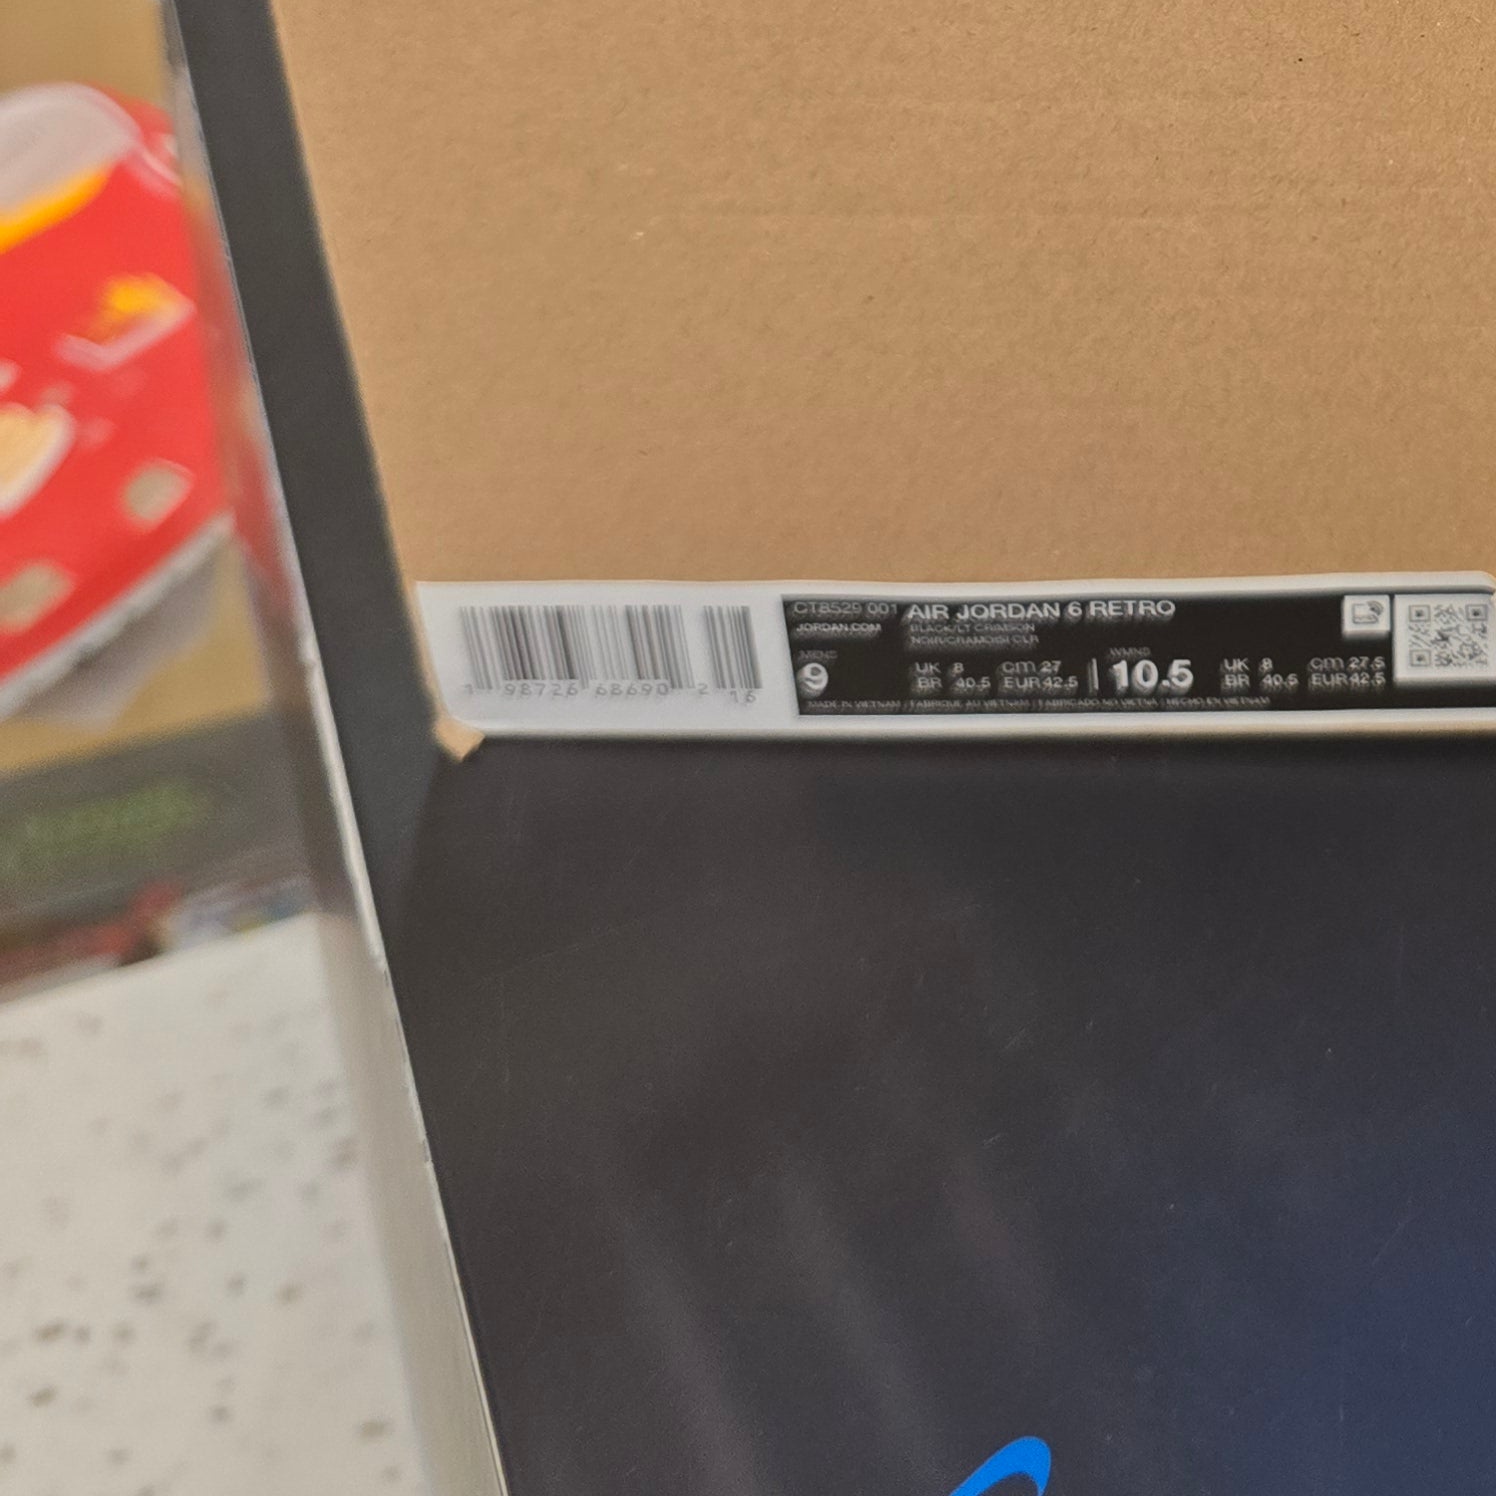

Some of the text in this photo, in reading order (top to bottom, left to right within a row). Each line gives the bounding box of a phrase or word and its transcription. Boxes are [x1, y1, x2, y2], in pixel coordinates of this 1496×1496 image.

[907, 599, 1177, 620] AIR JORDAN 6 RETRO
[796, 622, 882, 633] JORDAN.COM
[914, 661, 941, 675] UK
[1040, 660, 1062, 675] 27
[1223, 657, 1250, 671] UK
[1347, 656, 1386, 671] 27.5
[799, 662, 829, 691] 9
[1111, 658, 1194, 688] 10.5
[1224, 672, 1386, 686] BR 40.5 EUR 42.5
[917, 675, 1079, 689] BR 40.5 EUR 42.5
